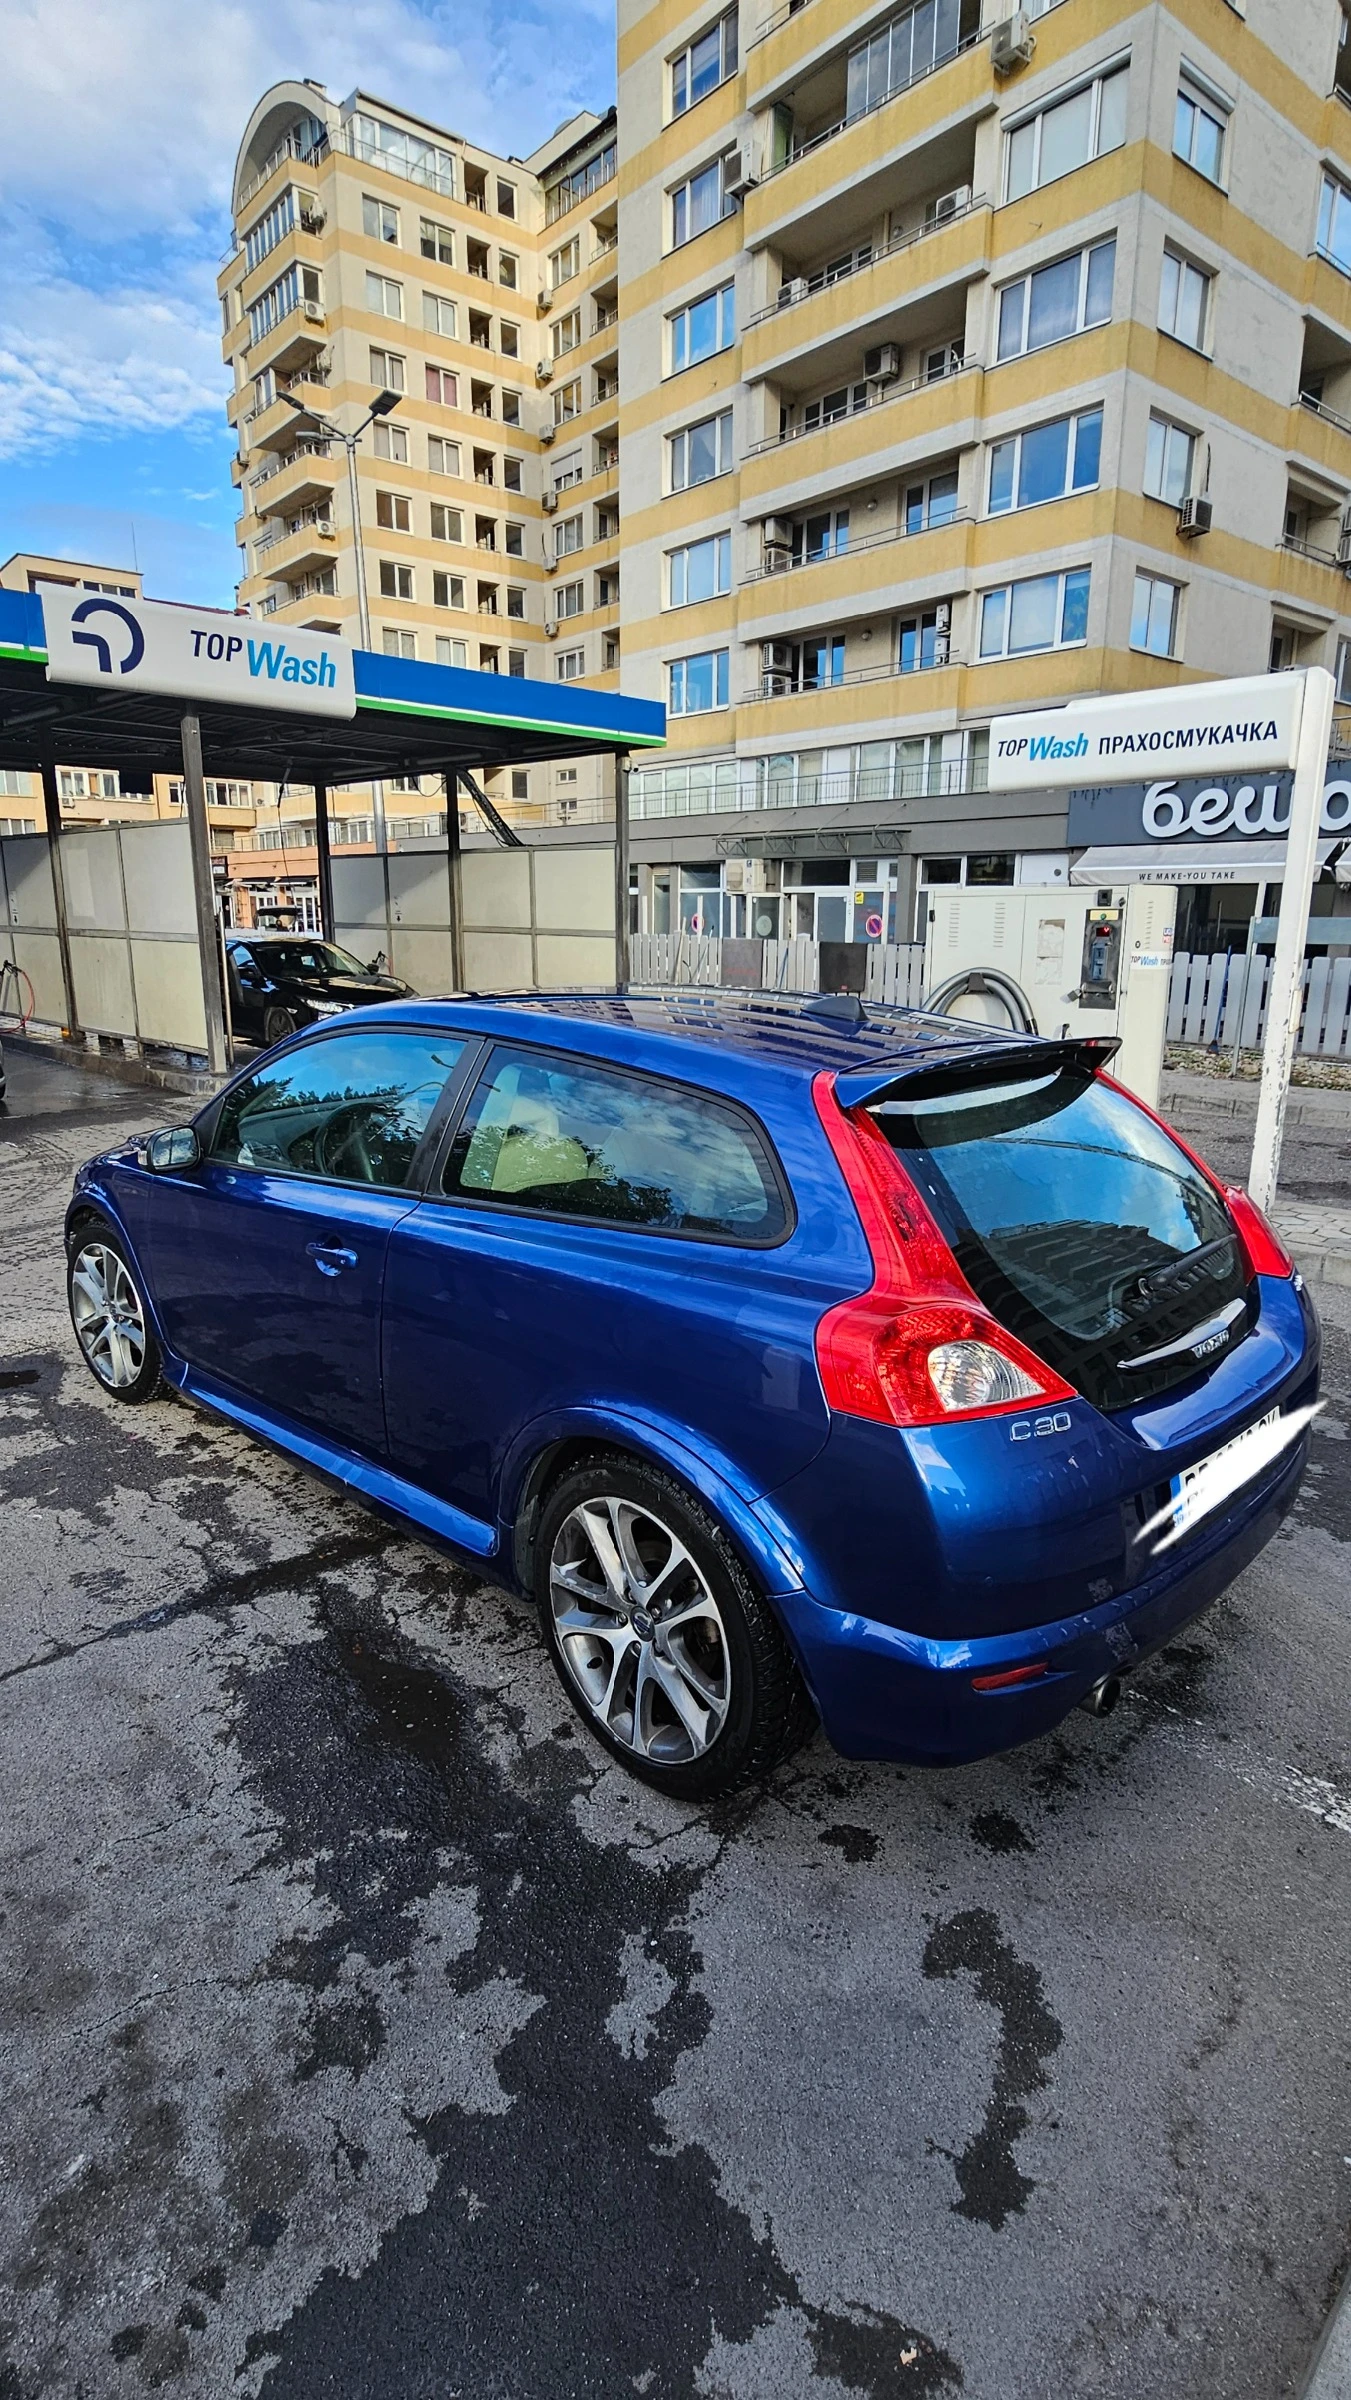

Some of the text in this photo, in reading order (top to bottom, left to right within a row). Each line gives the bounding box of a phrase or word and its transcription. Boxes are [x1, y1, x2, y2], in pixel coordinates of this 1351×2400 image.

[190, 630, 336, 688] TOP Wash
[998, 720, 1278, 761] TOP Wash ПРАХОСМУКАЧКА
[1139, 871, 1235, 881] WE MAKE-YOU TAKE
[1010, 1411, 1072, 1442] C30
